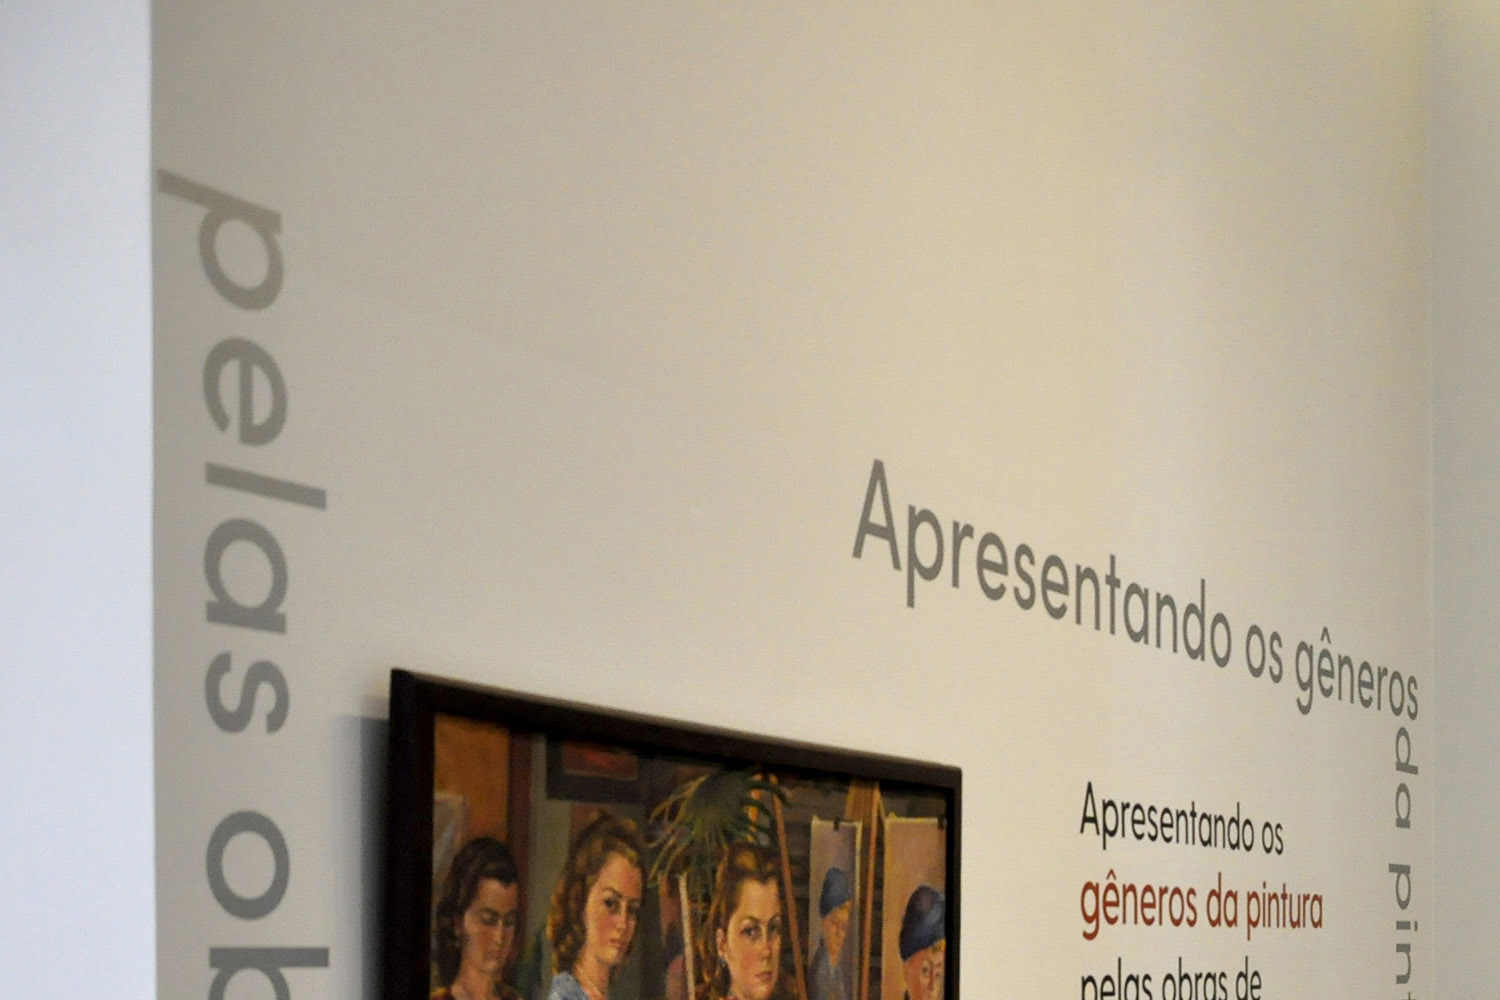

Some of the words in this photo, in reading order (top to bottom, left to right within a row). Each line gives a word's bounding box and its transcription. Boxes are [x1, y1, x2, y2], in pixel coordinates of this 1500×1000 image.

[156, 169, 327, 735] pelas
[853, 458, 1232, 668] Apresentando
[1246, 624, 1284, 684] os
[1295, 627, 1419, 720] gêneros
[1080, 781, 1255, 852] Apresentando
[1261, 819, 1284, 856] os
[1395, 727, 1419, 829] da
[1080, 868, 1198, 942] gêneros
[1206, 872, 1239, 929] da
[1247, 881, 1324, 941] pintura
